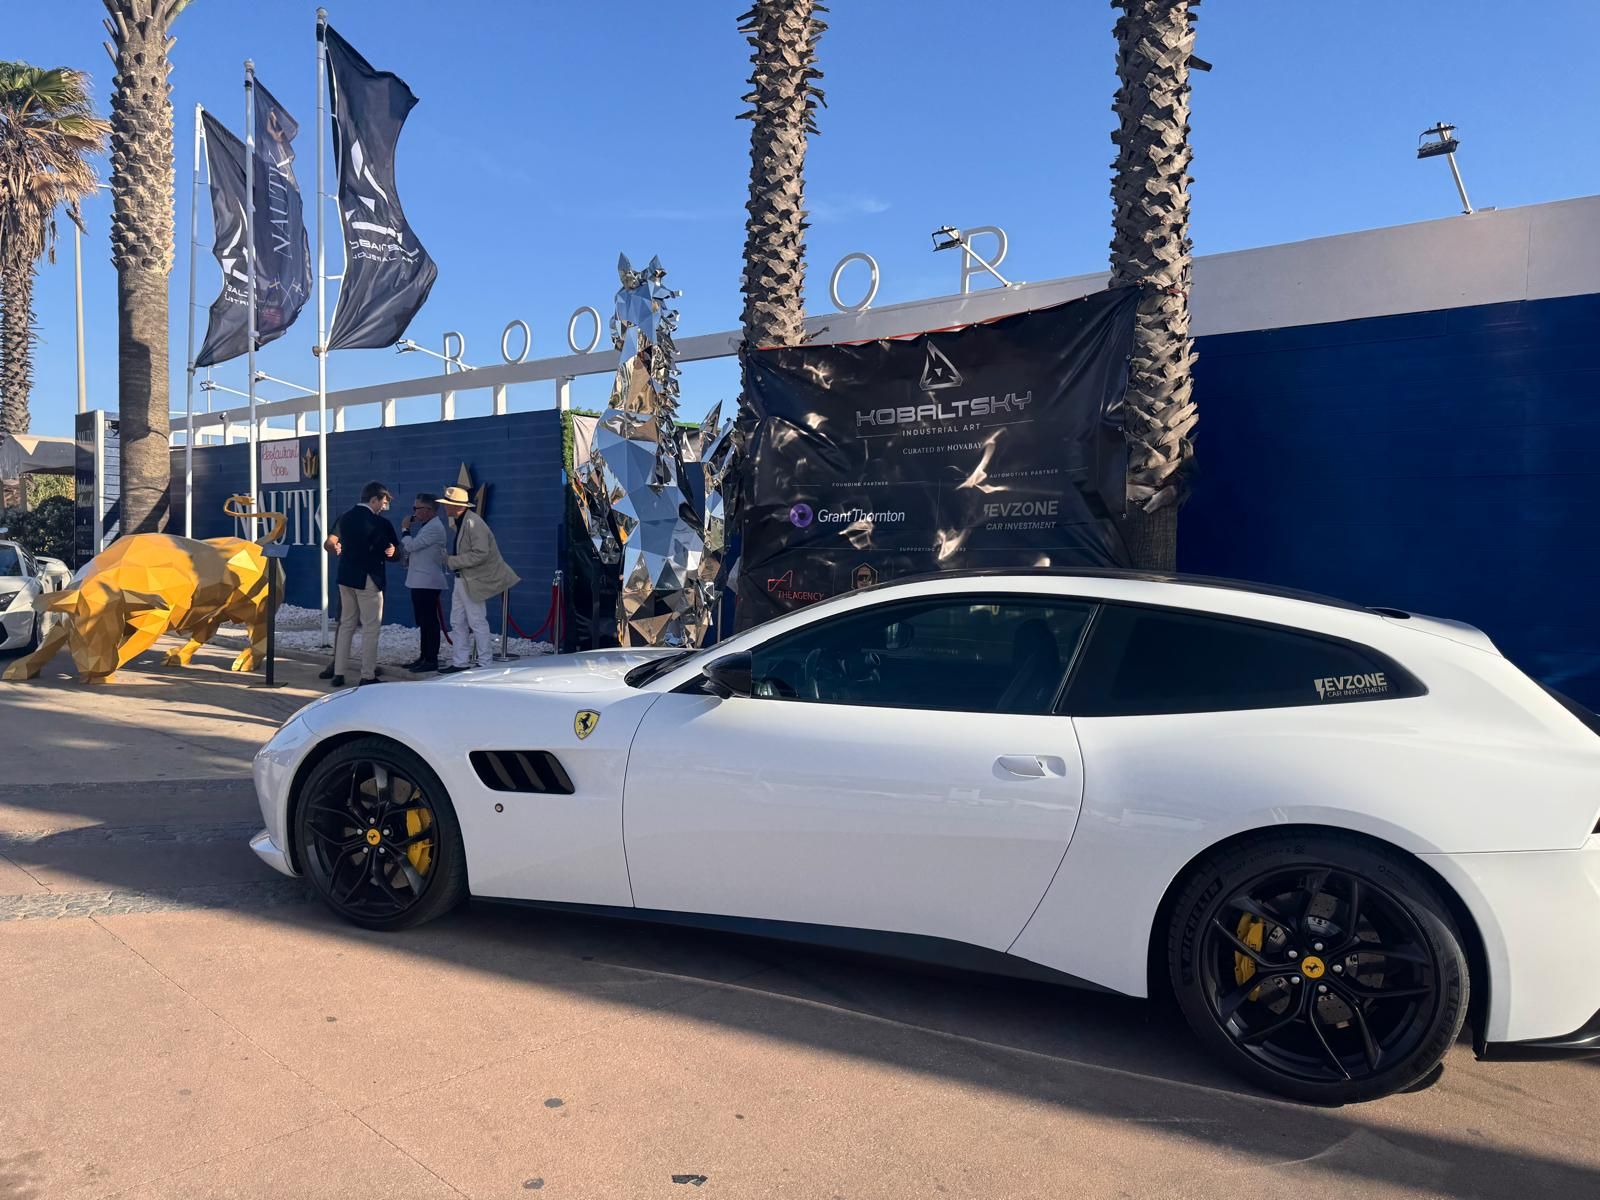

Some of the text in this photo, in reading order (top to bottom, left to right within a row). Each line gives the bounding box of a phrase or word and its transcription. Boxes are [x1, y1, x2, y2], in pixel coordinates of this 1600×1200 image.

[855, 390, 1032, 427] KOBALTSKY
[902, 423, 981, 437] INDUSTRIAL ART
[947, 442, 984, 452] NOVABAY
[817, 508, 905, 523] Grant Thornton
[988, 500, 1059, 518] EVZONE
[986, 521, 1057, 531] CAR INVESTMENT
[1323, 672, 1387, 691] EVZONE
[1343, 686, 1389, 696] INVESTMENT
